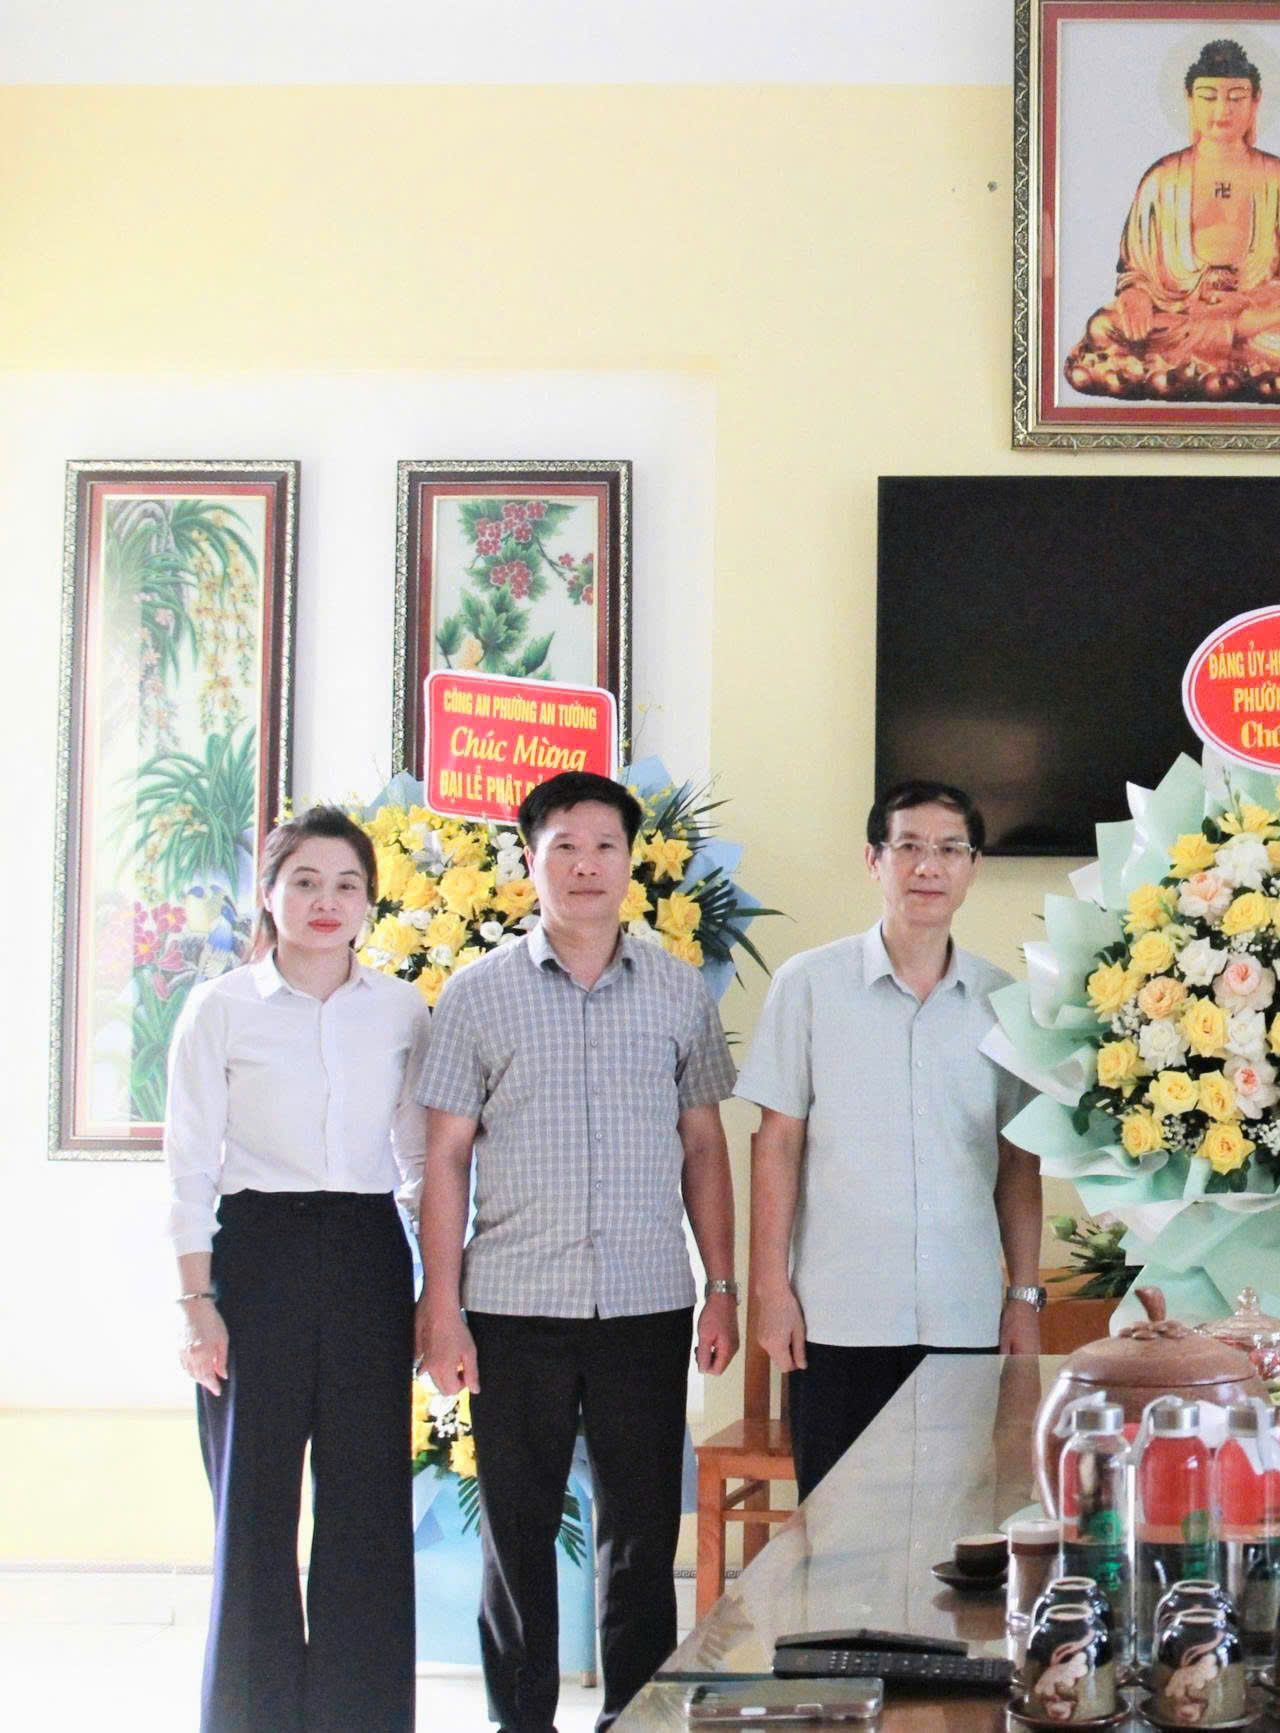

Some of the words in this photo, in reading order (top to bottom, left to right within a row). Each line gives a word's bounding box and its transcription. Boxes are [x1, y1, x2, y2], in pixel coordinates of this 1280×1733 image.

[1208, 642, 1245, 680] ĐẢNG
[444, 686, 473, 715] CÔNG
[475, 693, 490, 718] AN
[492, 694, 537, 723] PHƯỜNG
[539, 702, 555, 726] AN
[451, 726, 507, 762] Chúc
[512, 734, 587, 772] Mừng
[440, 769, 463, 804] ĐẠI
[466, 765, 483, 800] LỄ
[486, 773, 522, 811] PHẬT
